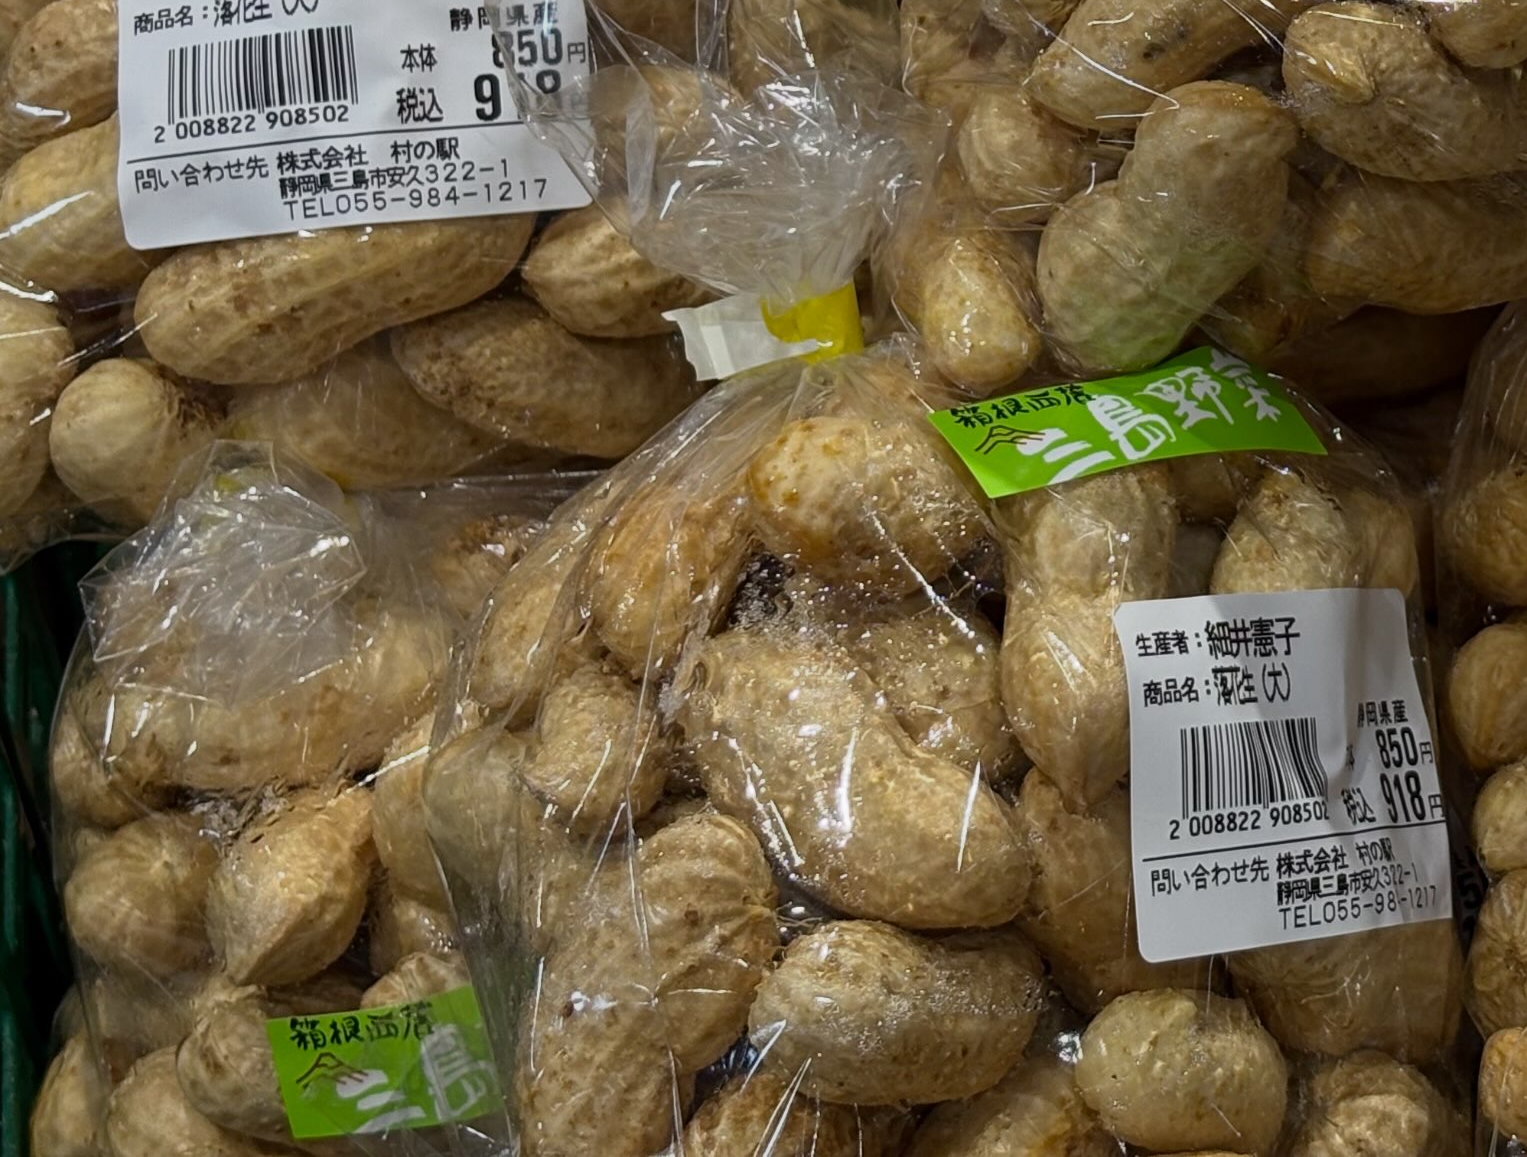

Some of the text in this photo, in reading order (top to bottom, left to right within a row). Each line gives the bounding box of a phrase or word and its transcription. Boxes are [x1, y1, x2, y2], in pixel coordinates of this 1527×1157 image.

[401, 44, 437, 73] 本体
[154, 105, 349, 144] 2 008822 908502
[396, 86, 444, 124] 税込
[134, 136, 460, 194] 問い合わせ先 株式会社 村の駅
[284, 178, 548, 222] TEL055-984-1217
[1016, 348, 1281, 485] 三島野菜
[1169, 801, 1329, 841] 2 008822 908502
[1151, 837, 1395, 896] 問い合わせ先 株式会社 村の駅
